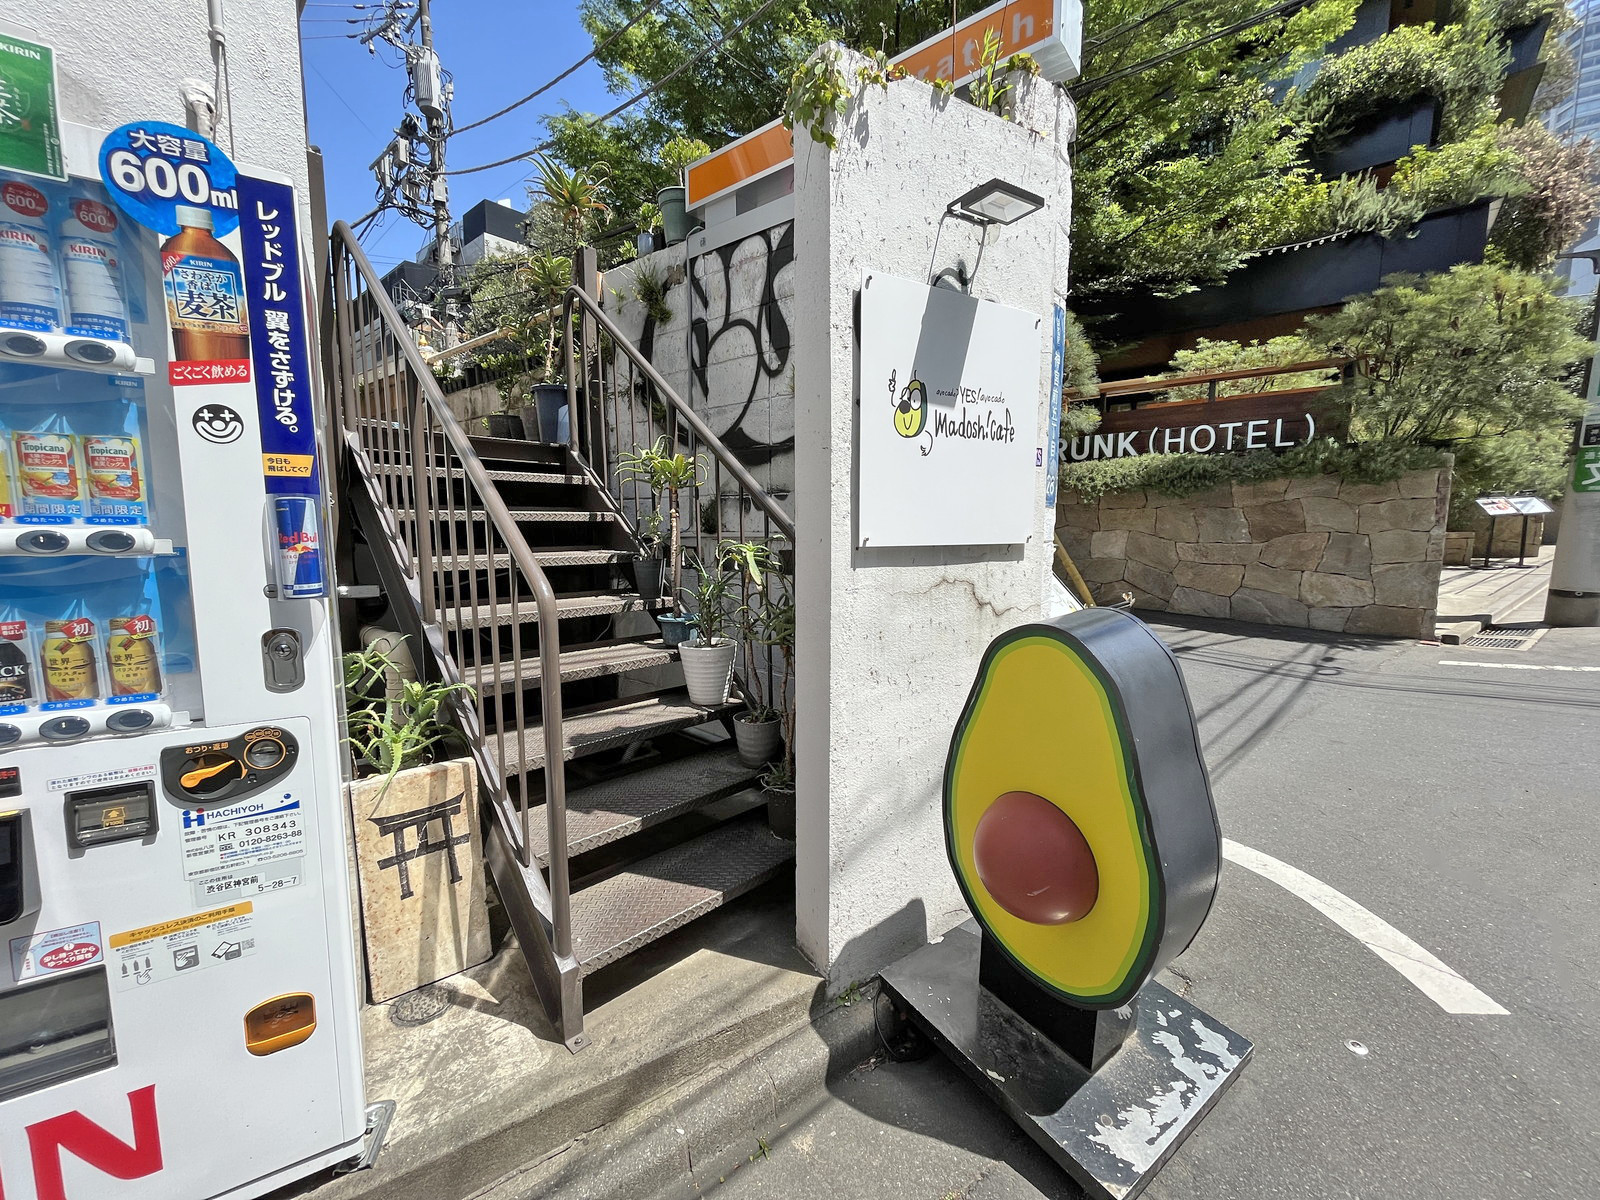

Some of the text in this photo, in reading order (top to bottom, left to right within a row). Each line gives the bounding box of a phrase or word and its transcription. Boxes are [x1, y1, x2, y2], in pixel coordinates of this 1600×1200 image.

[0, 43, 41, 60] KIRIN
[129, 129, 209, 162] 大容量
[69, 244, 107, 257] KIRIN
[257, 200, 287, 302] レッドブル
[189, 259, 213, 269] KIRIN
[180, 269, 227, 284] さわやか
[187, 279, 225, 293] 香ばし
[178, 289, 236, 320] 麦茶
[173, 365, 248, 380] ごくごく飲める
[115, 379, 138, 387] KIRIN
[22, 442, 65, 452] Tropicana
[89, 446, 128, 455] Tropicana
[1058, 431, 1139, 462] RUNK
[71, 622, 89, 636] 初
[133, 619, 149, 633] 初
[0, 664, 26, 678] CK
[206, 803, 264, 820] HACHIYOH
[218, 820, 297, 842] KR 308343
[239, 830, 303, 848] 0120-8263-88
[206, 876, 259, 894] 渋谷区神宮前
[0, 1083, 164, 1200] N
